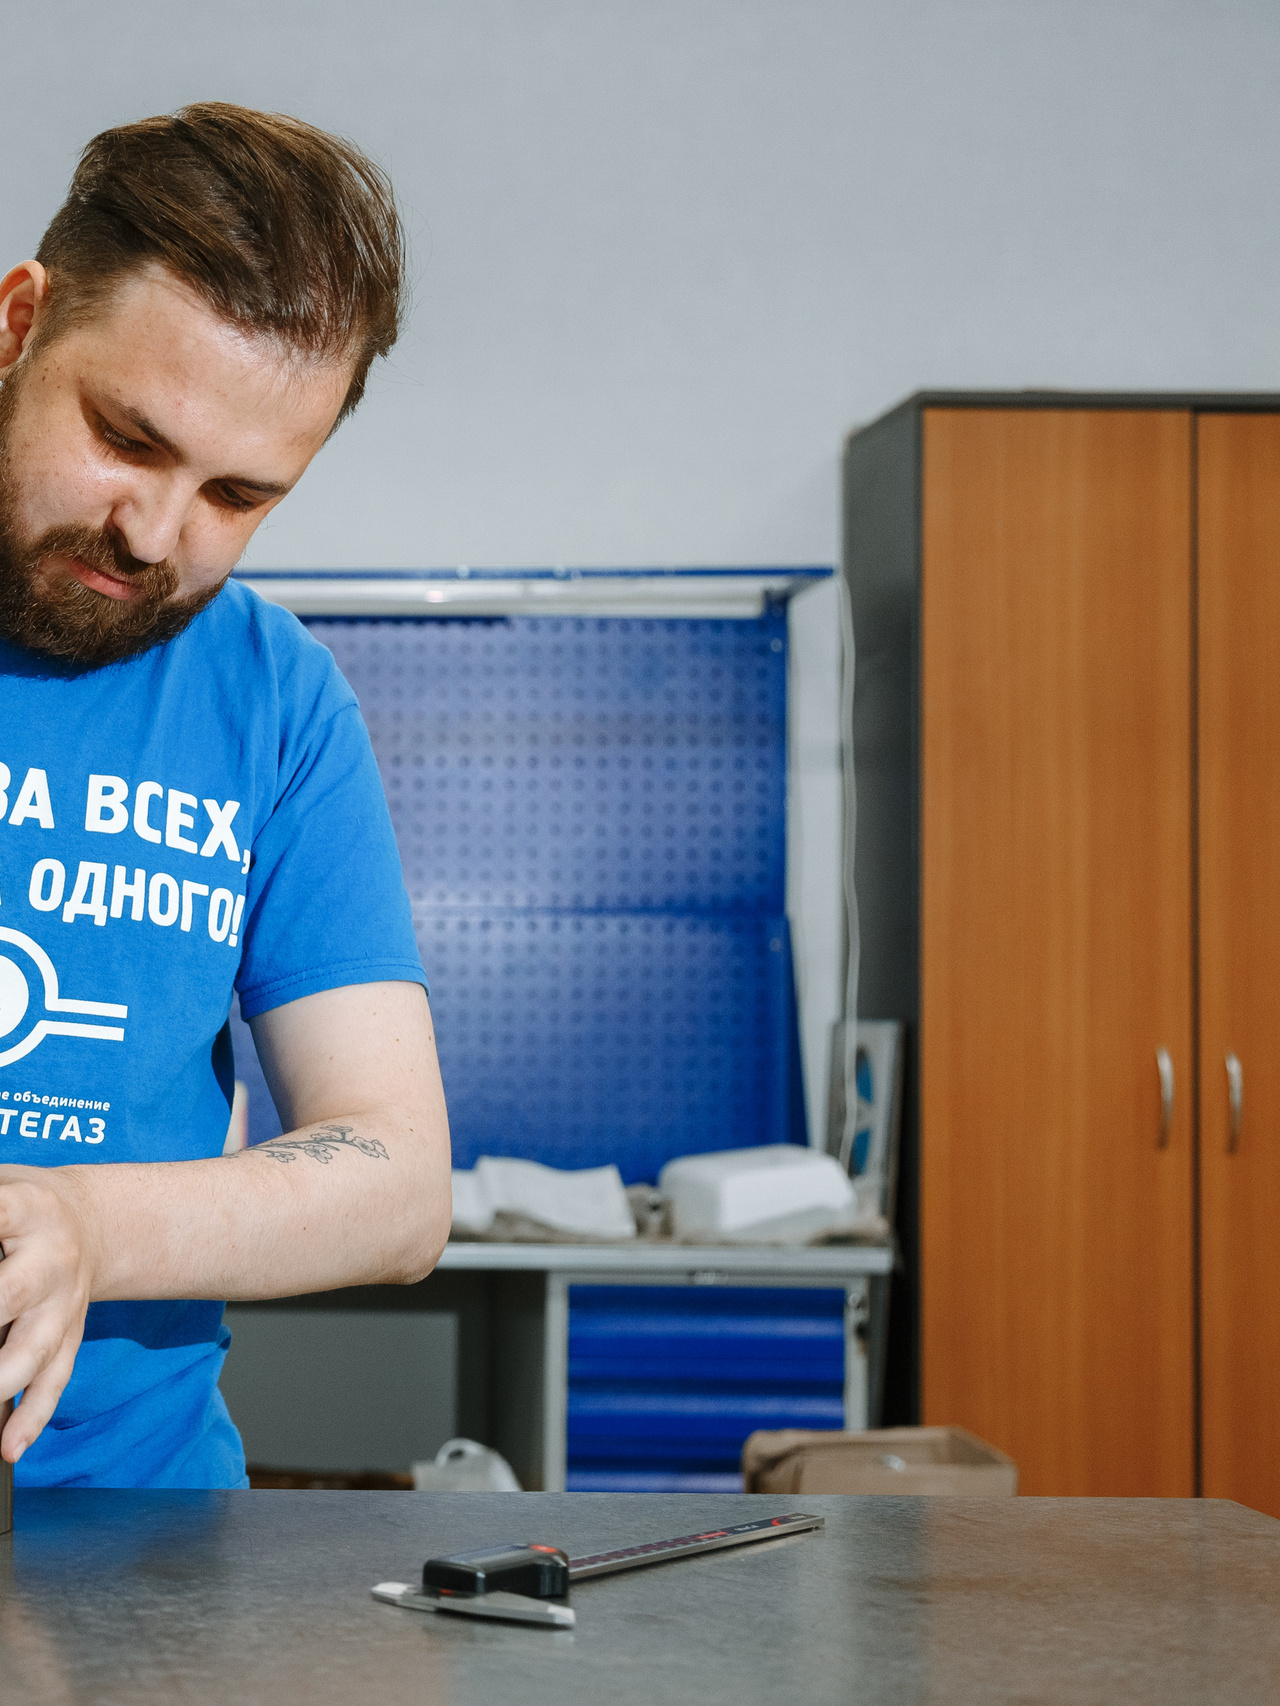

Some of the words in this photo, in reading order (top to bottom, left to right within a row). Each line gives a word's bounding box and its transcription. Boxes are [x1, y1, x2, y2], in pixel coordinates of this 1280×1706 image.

[84, 774, 251, 875] ВСЕХ,
[28, 858, 246, 948] ОДНОГО!
[13, 1090, 111, 1112] объединение
